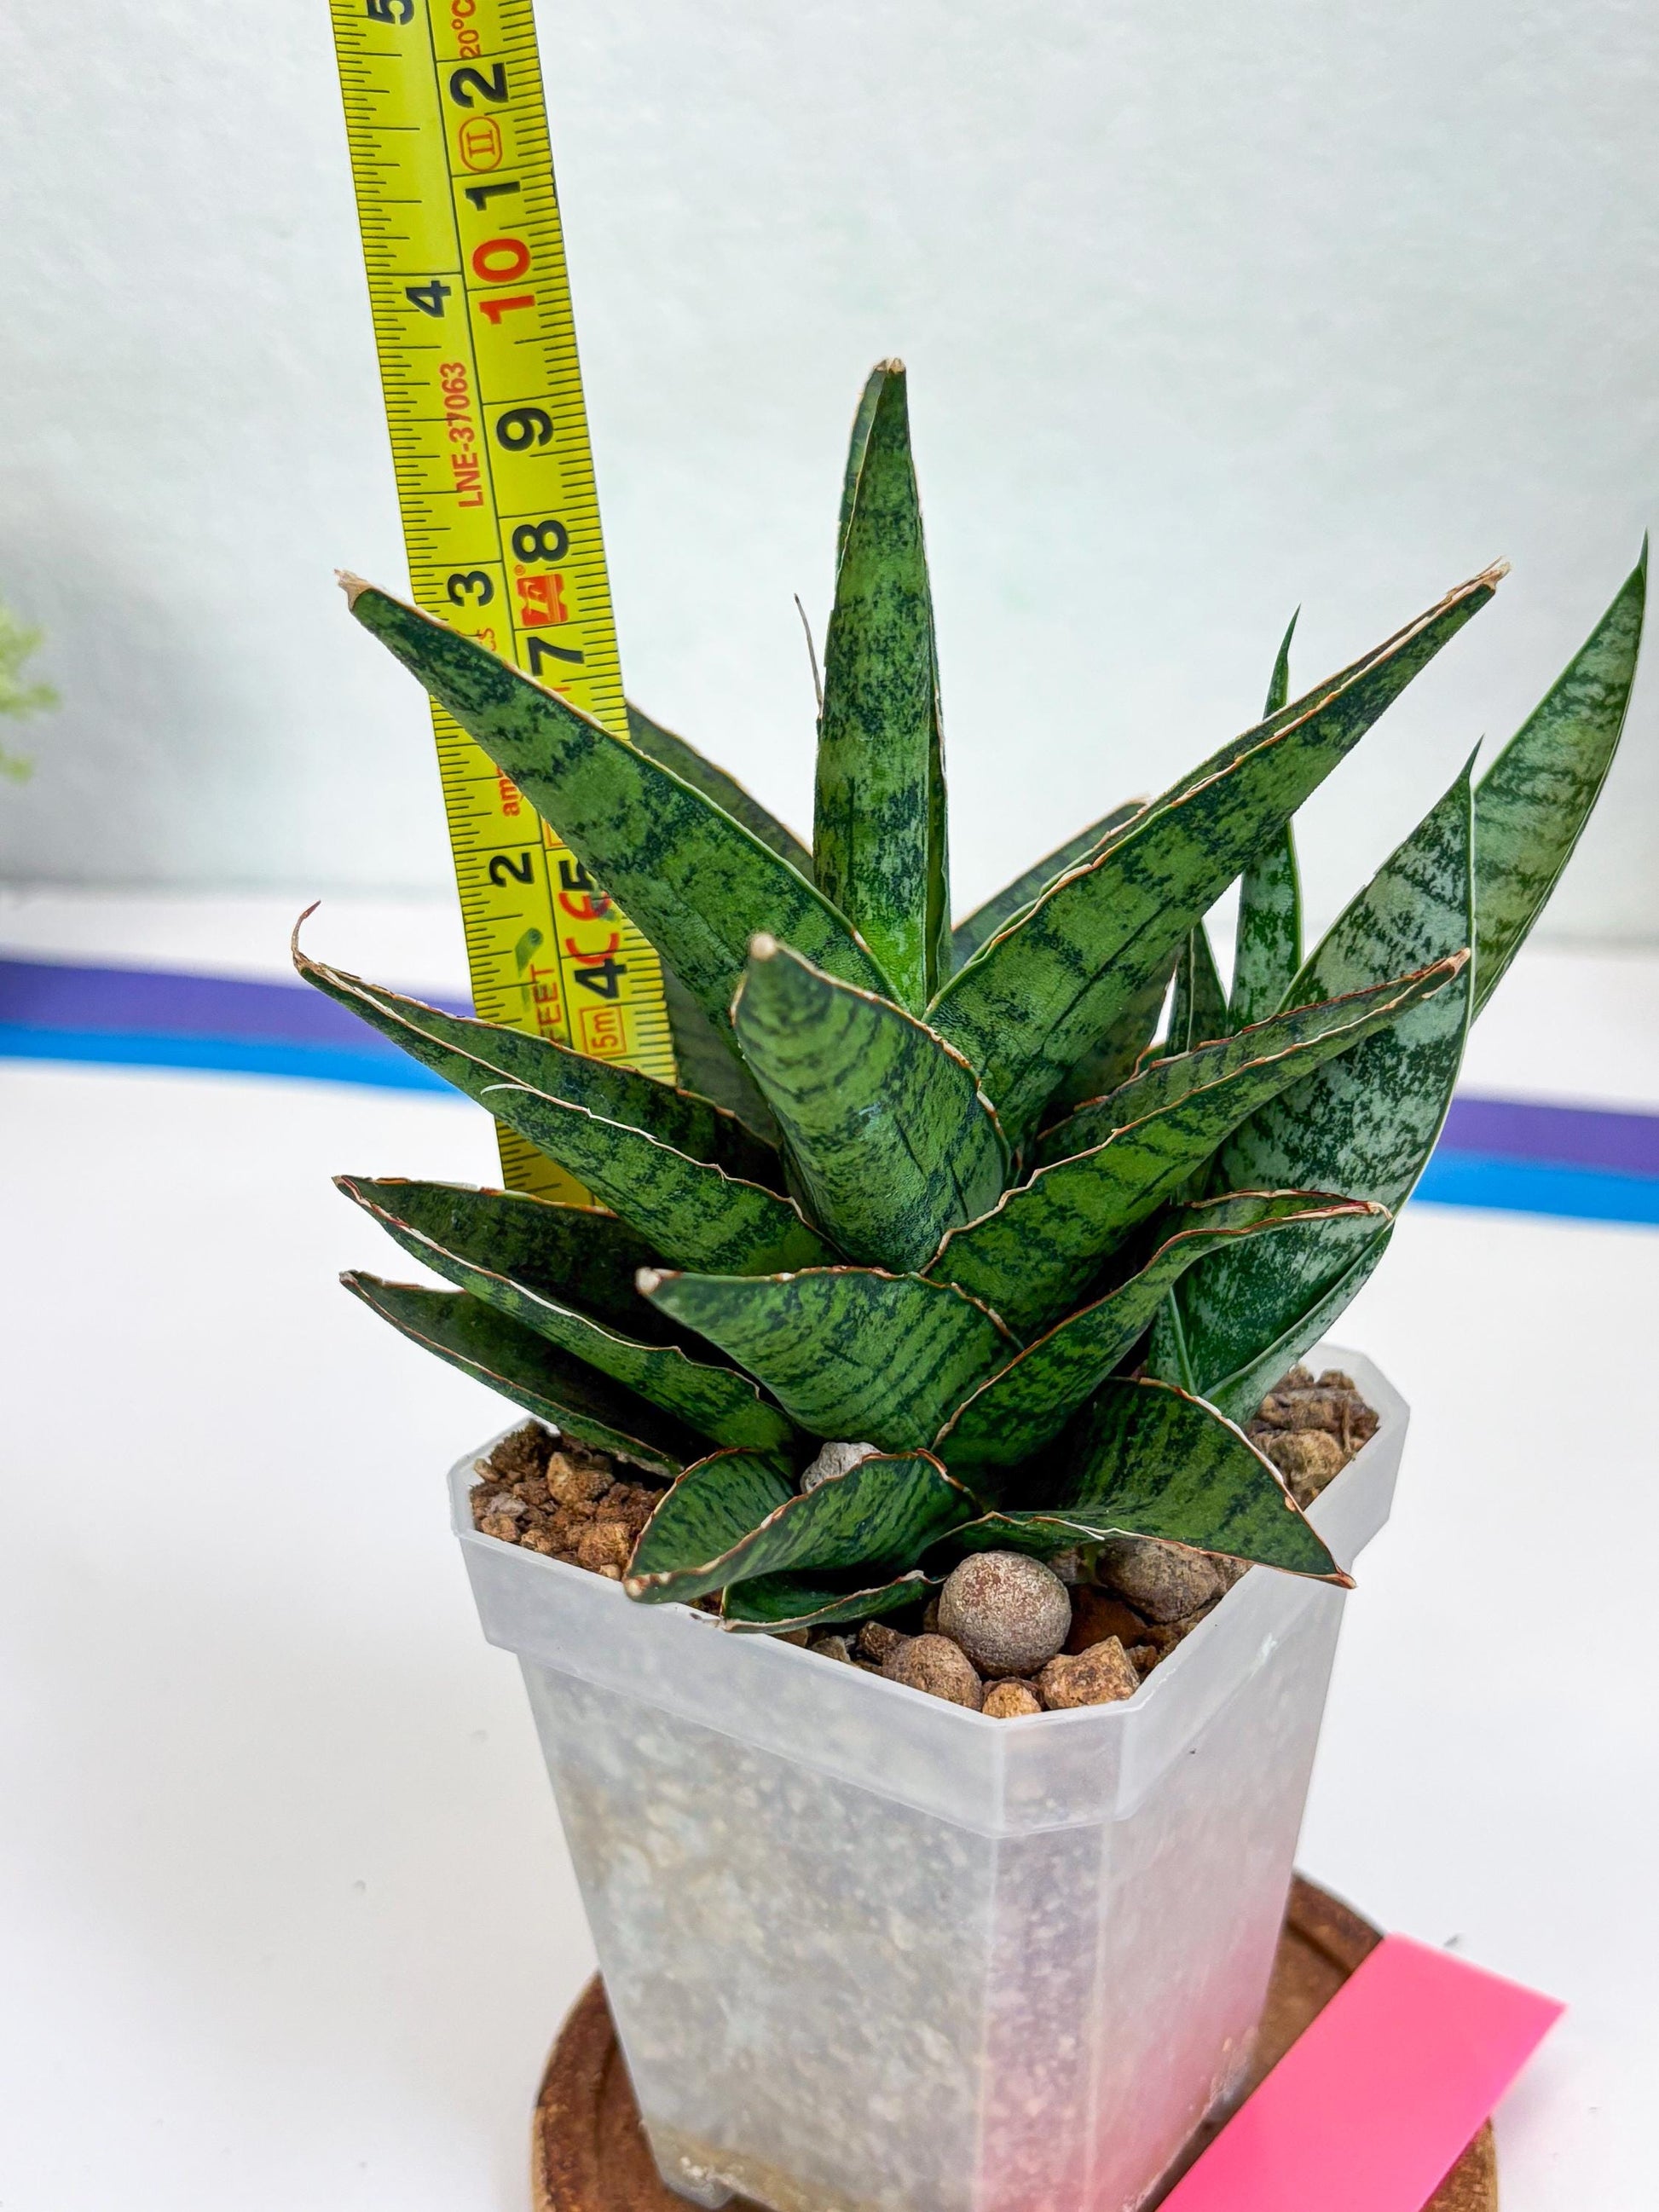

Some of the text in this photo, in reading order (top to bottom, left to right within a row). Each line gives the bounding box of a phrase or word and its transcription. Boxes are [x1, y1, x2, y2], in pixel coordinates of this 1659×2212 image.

[449, 62, 509, 108] 2
[465, 181, 522, 211] 1
[405, 280, 452, 319] 4
[471, 237, 536, 326] 10
[439, 361, 484, 508] LNE-37063
[495, 407, 554, 452] 9
[512, 519, 570, 563] 8
[447, 570, 494, 608] 3
[527, 637, 584, 676] 7
[488, 852, 535, 888] 2
[574, 957, 628, 1000] 4
[591, 1010, 620, 1050] 5m
